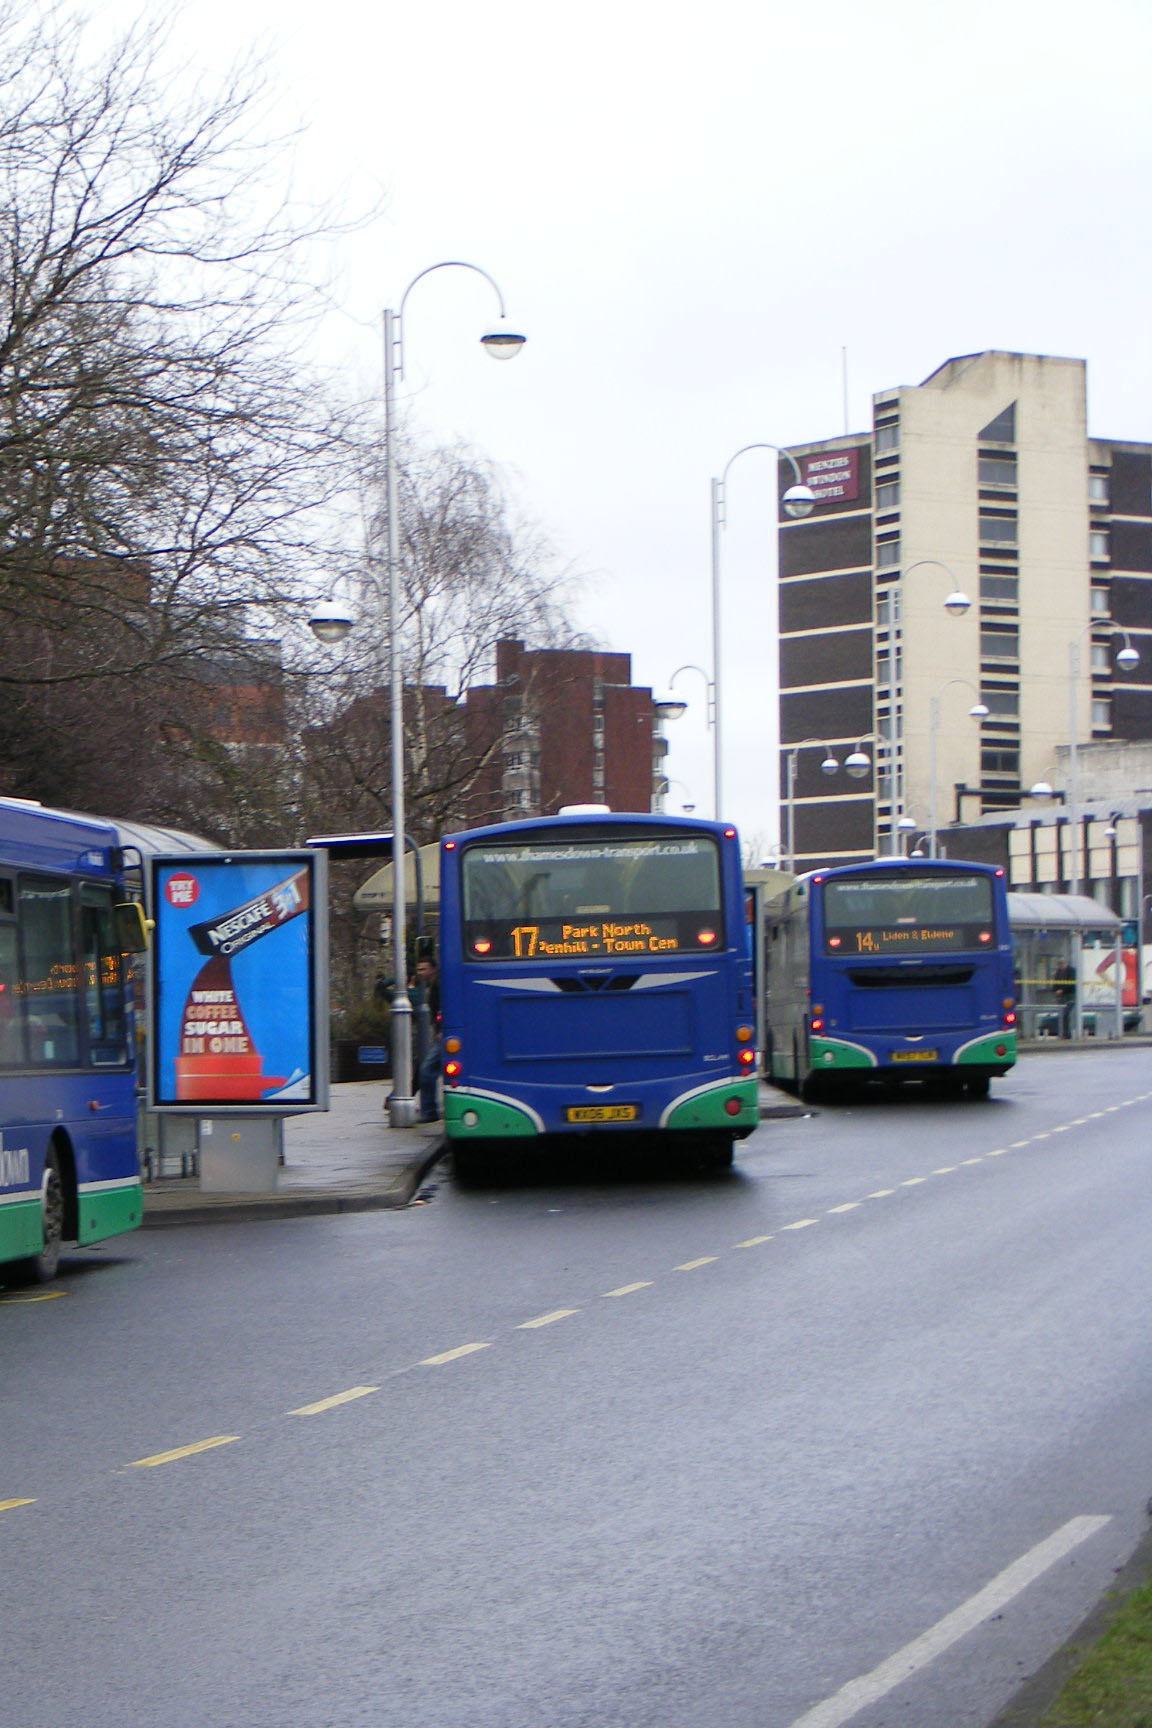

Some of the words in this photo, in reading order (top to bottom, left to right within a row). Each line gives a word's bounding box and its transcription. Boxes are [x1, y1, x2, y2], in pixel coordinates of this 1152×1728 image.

[562, 924, 599, 940] Park
[602, 922, 652, 938] North
[511, 926, 540, 957] 17
[603, 938, 647, 953] Town
[648, 936, 679, 951] Cen
[855, 931, 873, 952] 14
[184, 1021, 243, 1035] SUGAR
[183, 1037, 205, 1054] IN
[209, 1036, 249, 1053] ONE
